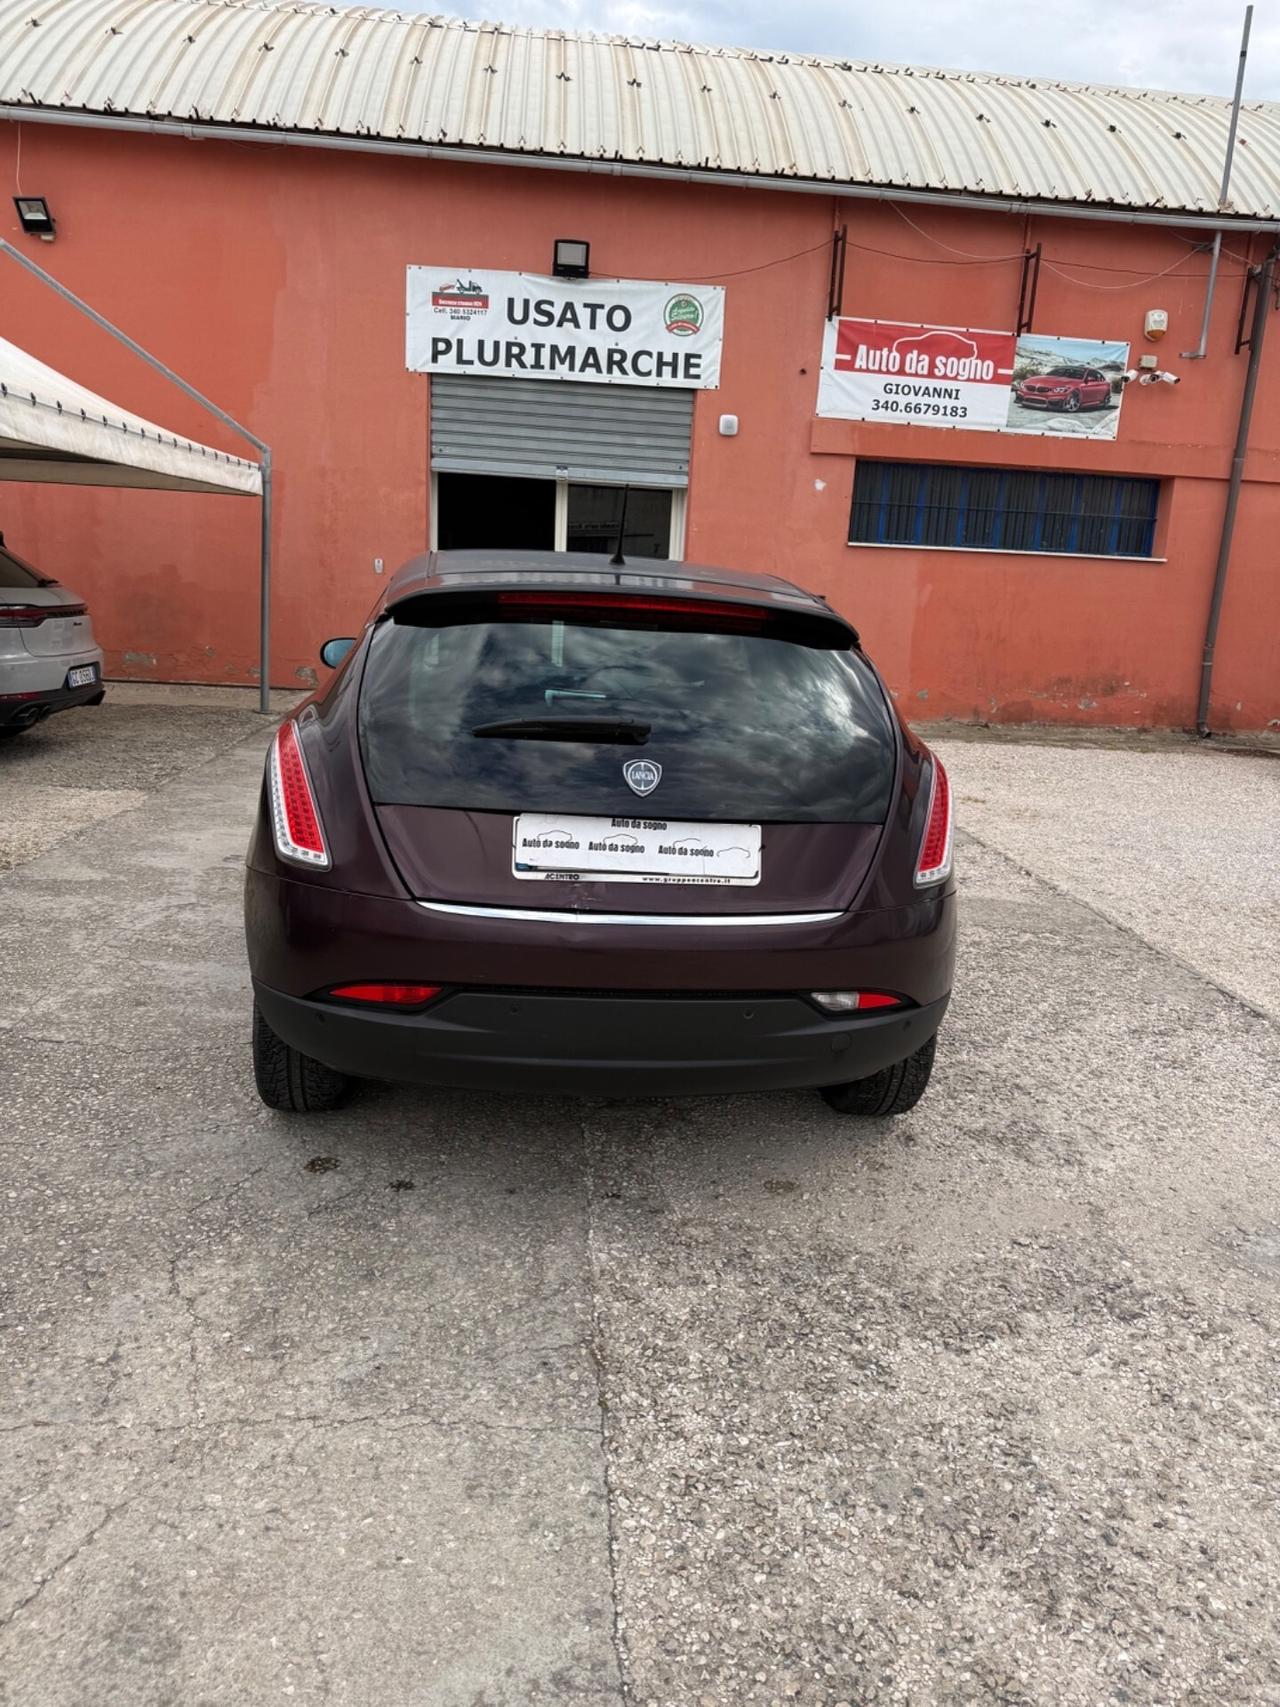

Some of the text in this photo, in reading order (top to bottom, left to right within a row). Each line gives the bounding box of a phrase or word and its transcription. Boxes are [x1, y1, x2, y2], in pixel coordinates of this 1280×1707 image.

[506, 297, 632, 332] USATO
[430, 336, 703, 380] PLURIMARCHE
[854, 344, 994, 381] Auto da sogno
[883, 382, 961, 400] GIOVANNI
[871, 399, 968, 418] 340.6679183
[631, 770, 655, 780] LANCIA
[611, 818, 668, 831] Auto da sogno
[522, 838, 541, 848] Auto
[542, 839, 553, 848] da
[588, 841, 645, 854] Auto da sogno
[658, 845, 677, 855] Auto
[678, 846, 688, 856] da
